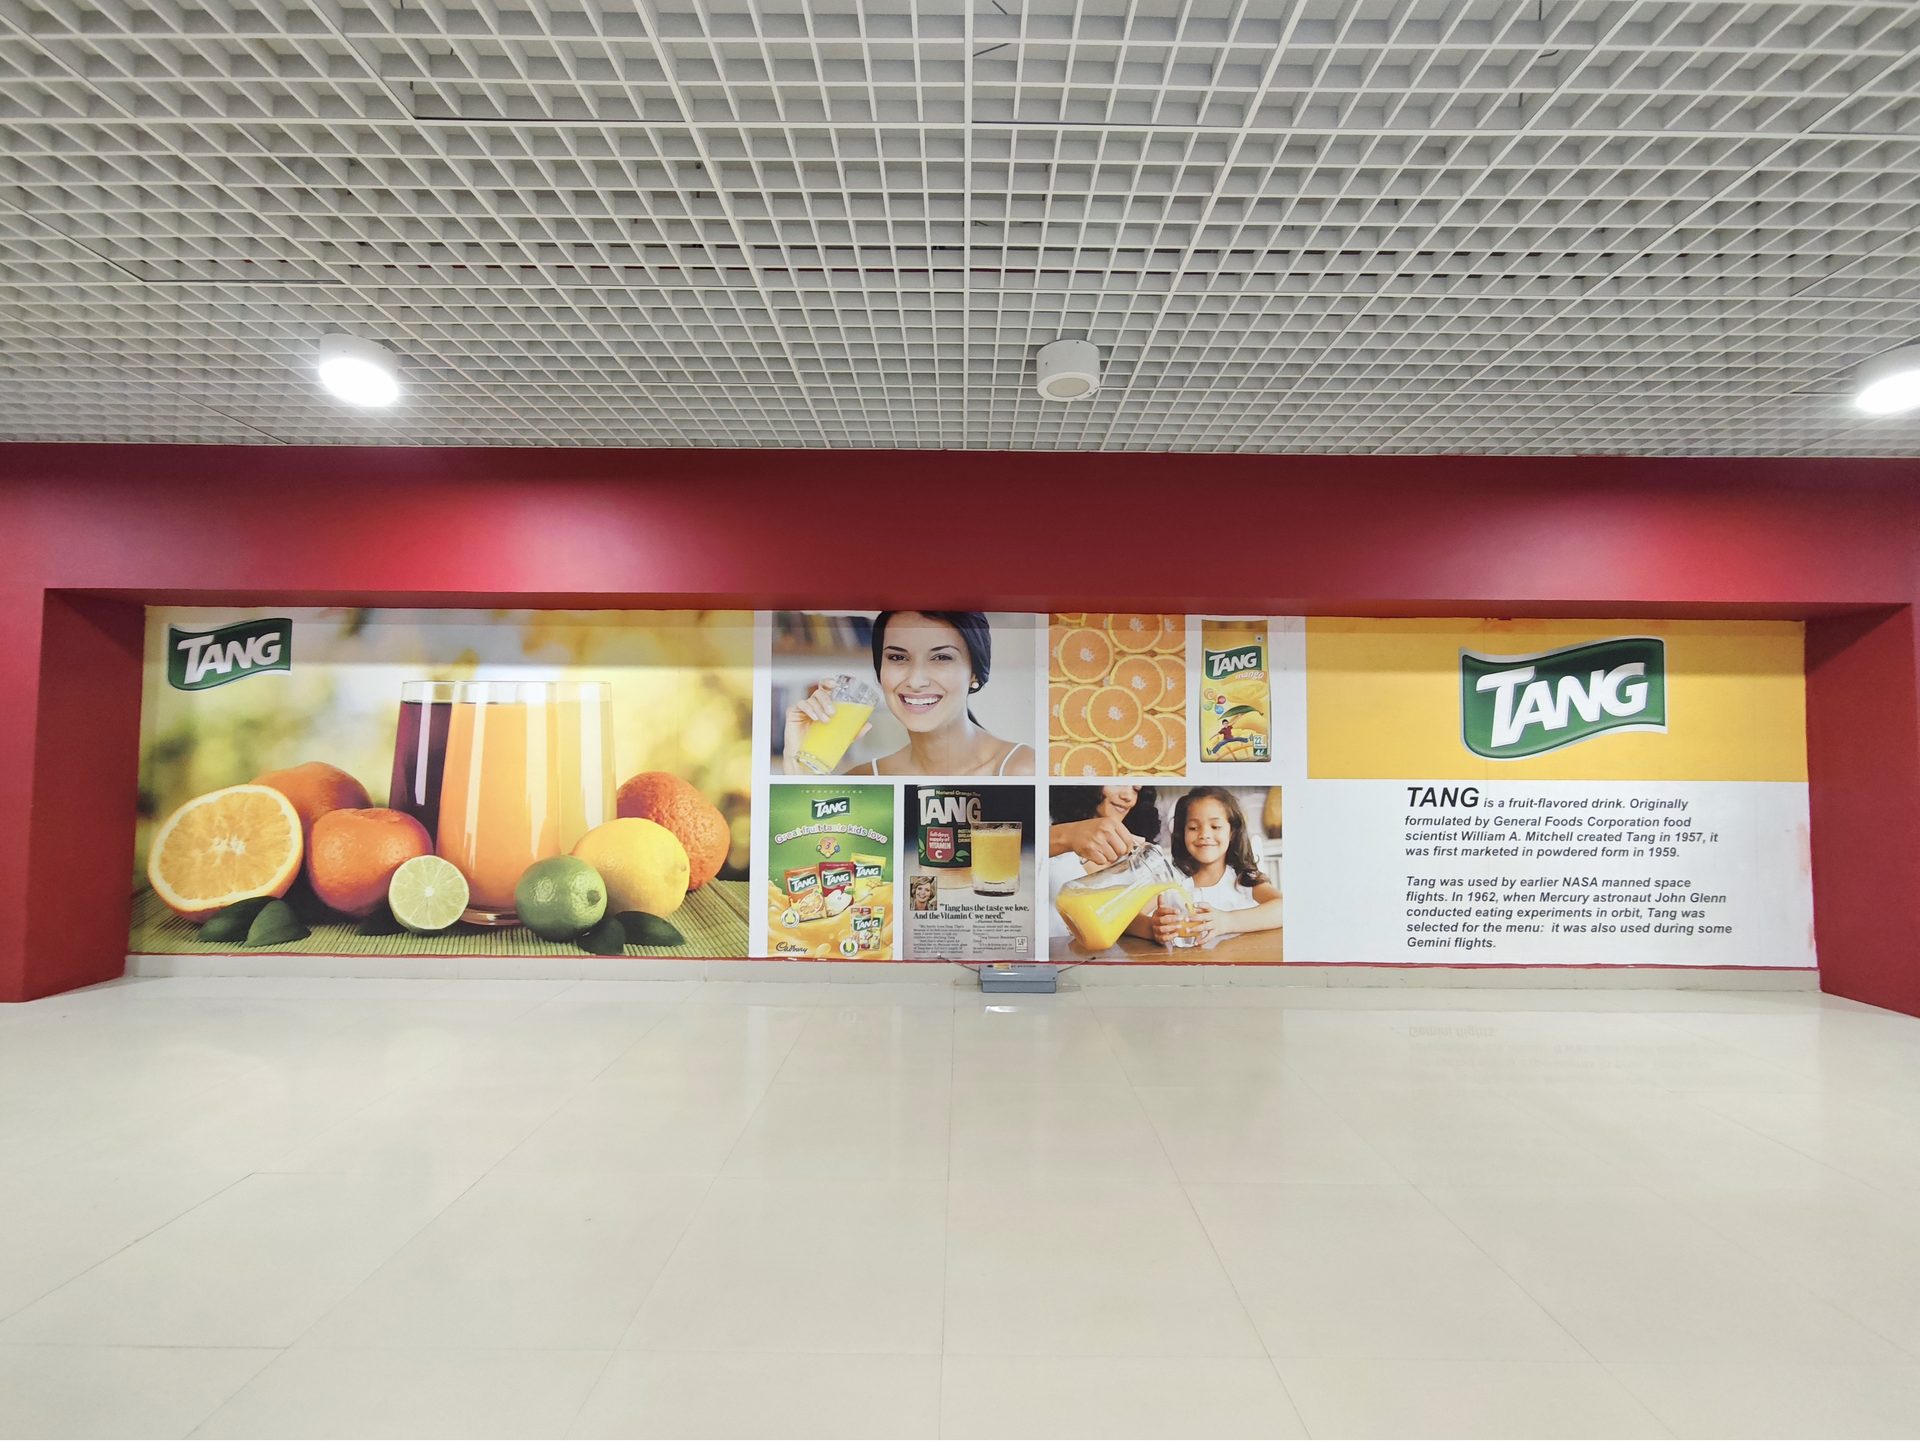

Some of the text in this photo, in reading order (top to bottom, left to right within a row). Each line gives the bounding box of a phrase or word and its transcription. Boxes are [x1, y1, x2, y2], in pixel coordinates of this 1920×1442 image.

[177, 632, 281, 684] TANG
[1209, 652, 1256, 677] TANG
[1476, 662, 1648, 748] TANG
[1407, 787, 1688, 811] TANG is a fruit-flavored drink. Originally
[814, 801, 847, 818] TANG
[918, 789, 981, 825] TANG
[1405, 816, 1691, 828] formulated by General Foods Corporation food
[847, 824, 867, 837] kids
[867, 829, 888, 844] love
[1405, 831, 1718, 844] scientist William A. Mitchell created Tang in 1957, it
[935, 850, 943, 858] C
[1406, 846, 1679, 859] was first marketed in powdered form in 1959.
[855, 866, 879, 877] TANG
[792, 876, 816, 892] TANG
[824, 873, 849, 886] TANG
[1406, 876, 1435, 888] Tang
[1468, 877, 1498, 887] used
[1502, 877, 1516, 889] by
[1520, 877, 1559, 887] earlier
[1563, 877, 1598, 887] NASA
[1602, 877, 1650, 887] manned
[1655, 880, 1691, 889] space
[1406, 891, 1726, 904] flights. In 1962, when Mercury astronaut John Glenn
[1406, 907, 1705, 920] conducted eating experiments in orbit, Tang was
[1406, 922, 1458, 932] selected
[1462, 922, 1479, 932] for
[1483, 923, 1502, 932] the
[1552, 923, 1559, 932] it
[1563, 925, 1587, 933] was
[1591, 923, 1616, 933] also
[1620, 923, 1650, 933] used
[1654, 923, 1694, 935] during
[1698, 925, 1732, 933] some
[776, 941, 808, 954] Cadbury
[1407, 937, 1496, 950] Gemini flights.
